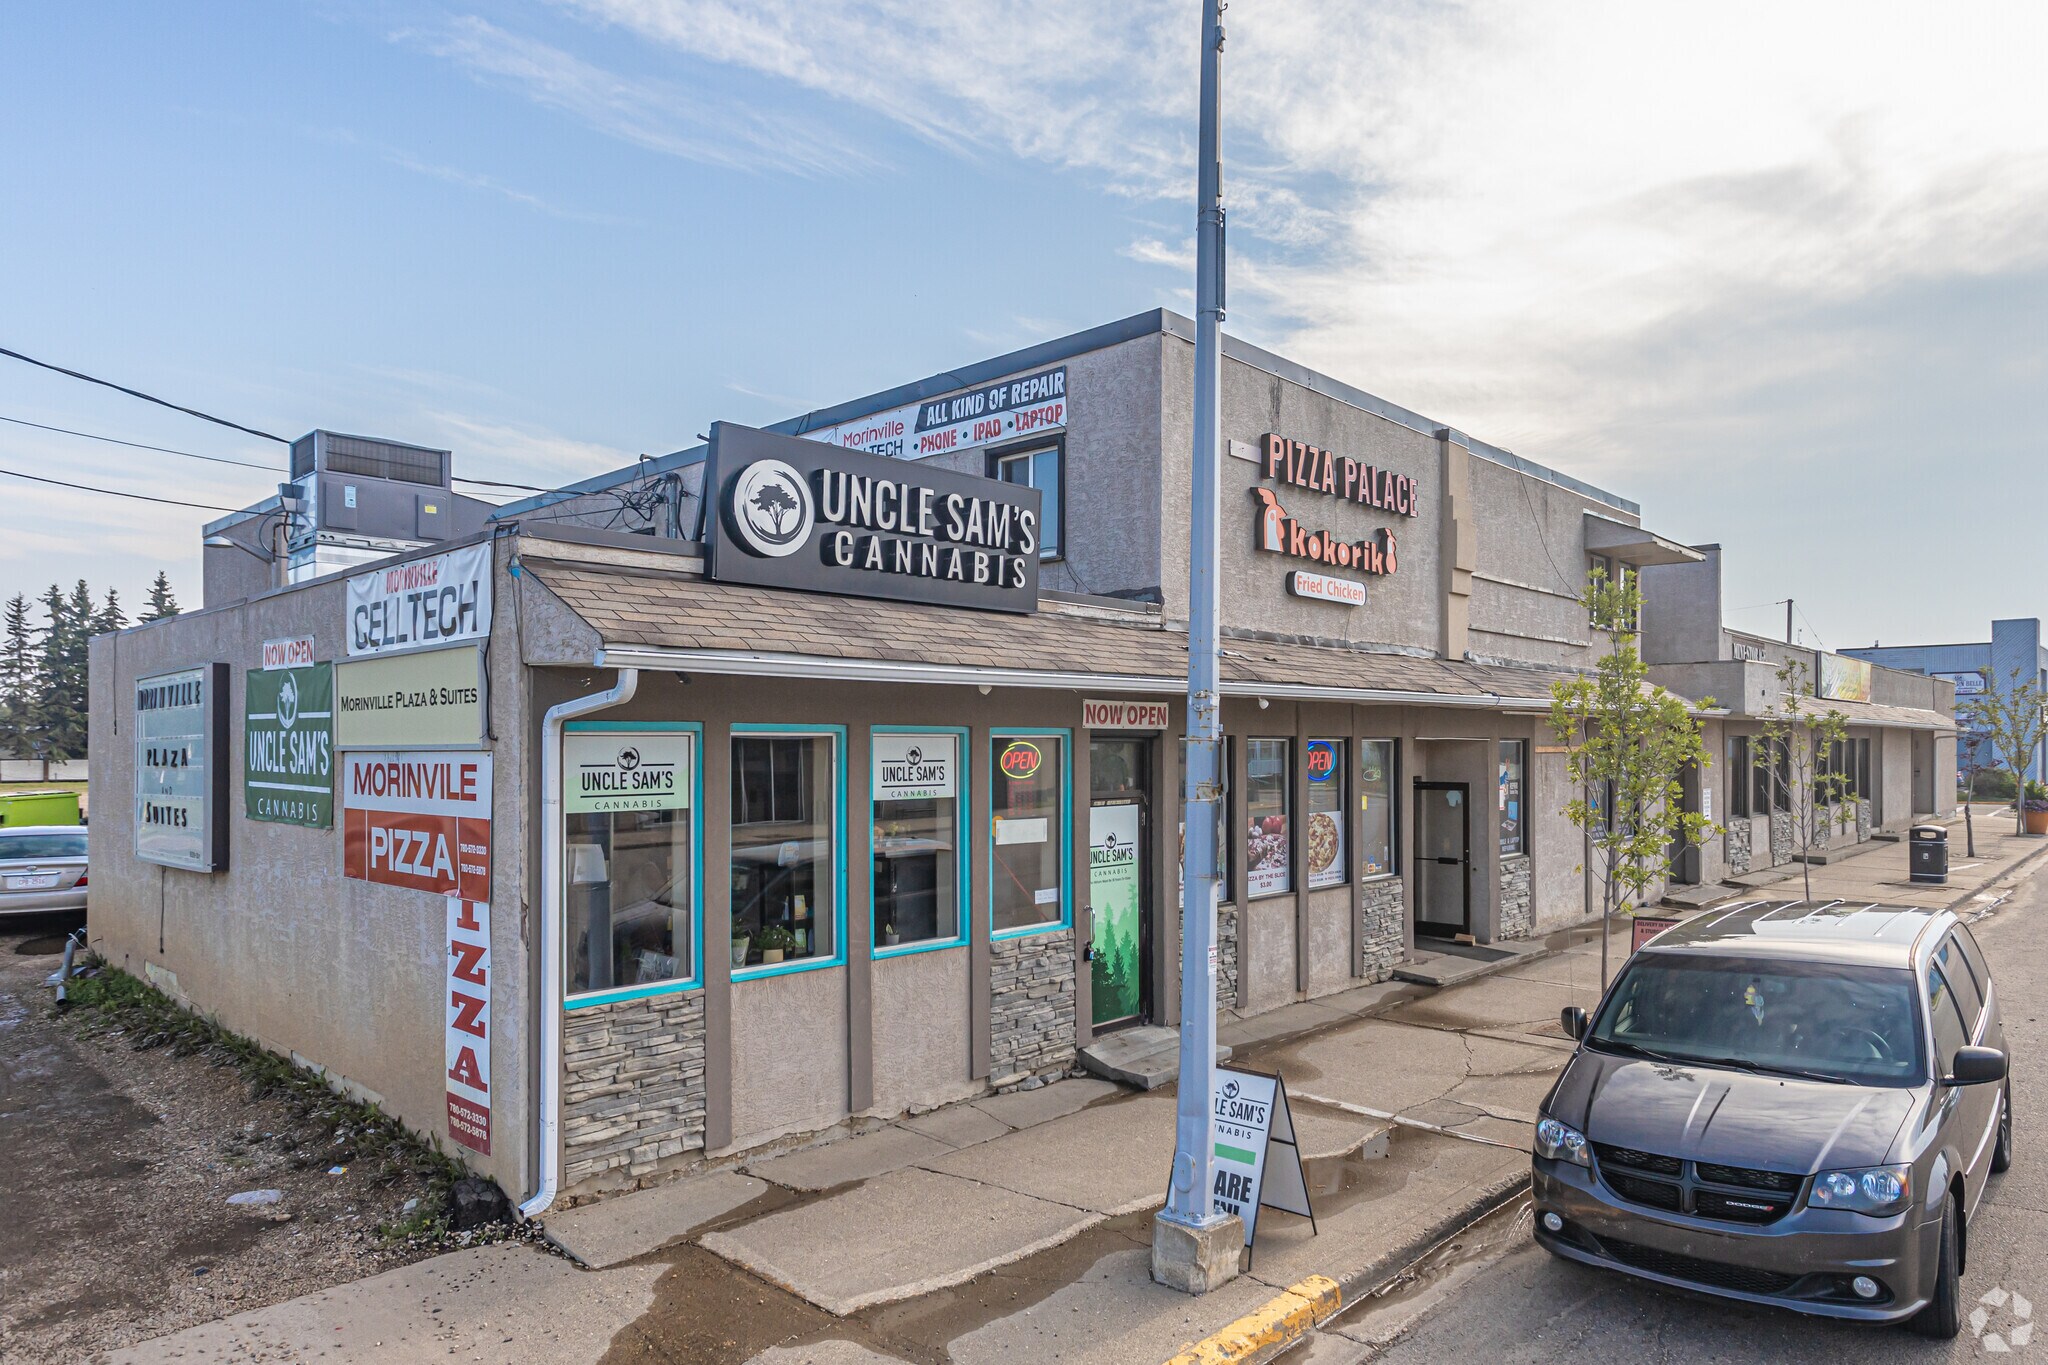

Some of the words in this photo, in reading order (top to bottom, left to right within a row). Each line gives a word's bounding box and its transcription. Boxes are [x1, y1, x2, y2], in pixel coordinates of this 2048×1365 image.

[927, 405, 947, 427] ALL
[951, 394, 984, 420] KIND
[989, 389, 1007, 410] OF
[1011, 371, 1064, 405] REPAIR
[843, 420, 904, 448] Morinville
[920, 429, 957, 454] PHONE
[973, 418, 1001, 441] IPAD
[1015, 403, 1063, 432] LAPTOP
[1267, 433, 1335, 495] PIZZA
[1344, 456, 1418, 518] PALACE
[822, 468, 935, 537] UNCLE
[946, 492, 1035, 555] SAM'S
[834, 530, 1027, 589] CANNABIS
[386, 561, 438, 594] MORINVILLE
[1296, 574, 1323, 594] Fried
[1326, 580, 1364, 602] Chicken
[264, 643, 287, 666] NOW
[288, 640, 313, 664] OPEN
[340, 695, 393, 711] MORINVILLE
[395, 691, 427, 709] PLAZA
[429, 688, 438, 705] &
[440, 687, 477, 704] SUITES
[1085, 703, 1123, 725] NOW
[1127, 705, 1167, 725] OPEN
[147, 748, 188, 767] PLAZA
[250, 730, 286, 774] UNCLE
[289, 730, 329, 776] SAM'S
[1002, 751, 1038, 770] OPEN
[353, 761, 477, 802] MORINVILE
[582, 771, 627, 791] UNCLE
[632, 770, 673, 790] SAM'S
[882, 766, 913, 782] UNCLE
[916, 765, 945, 781] SAM'S
[594, 799, 662, 810] CANNABIS
[891, 789, 937, 798] CANNABIS
[146, 801, 187, 827] SUITES
[258, 798, 318, 821] CANNABIS
[370, 825, 455, 881] PIZZA
[1112, 847, 1133, 862] SAM'S
[1094, 867, 1128, 878] CANNABIS
[448, 900, 488, 1093] IZZA
[449, 1102, 487, 1127] 780-572-3330
[1229, 1101, 1266, 1124] SAM'S
[450, 1116, 487, 1141] 780-572-5878
[1215, 1123, 1252, 1140] NABIS
[1214, 1169, 1253, 1204] ARE
[1725, 1200, 1768, 1211] DODGE
